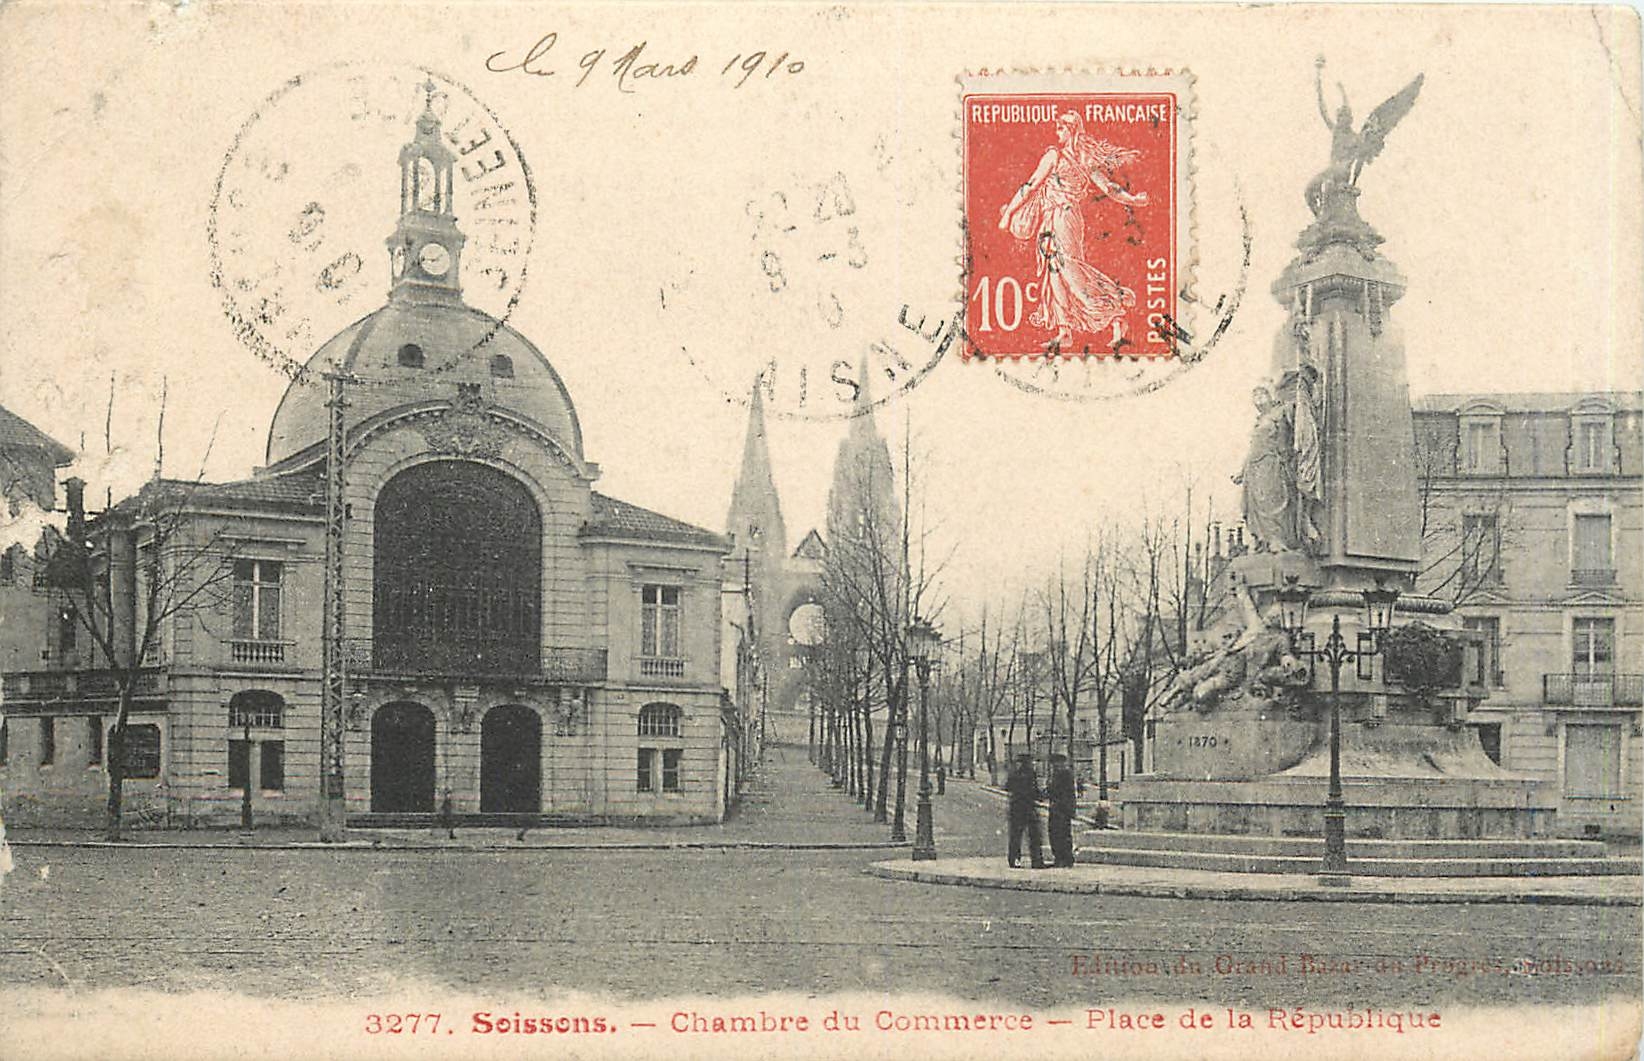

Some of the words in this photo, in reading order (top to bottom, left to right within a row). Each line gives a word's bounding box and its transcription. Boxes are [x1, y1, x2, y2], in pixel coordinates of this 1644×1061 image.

[575, 49, 607, 88] 9
[720, 51, 806, 89] 1910
[971, 104, 1058, 124] REPUBLIQUE
[1084, 104, 1168, 125] FRANÇAISE
[1146, 257, 1167, 344] POSTES
[1189, 735, 1217, 748] 1870
